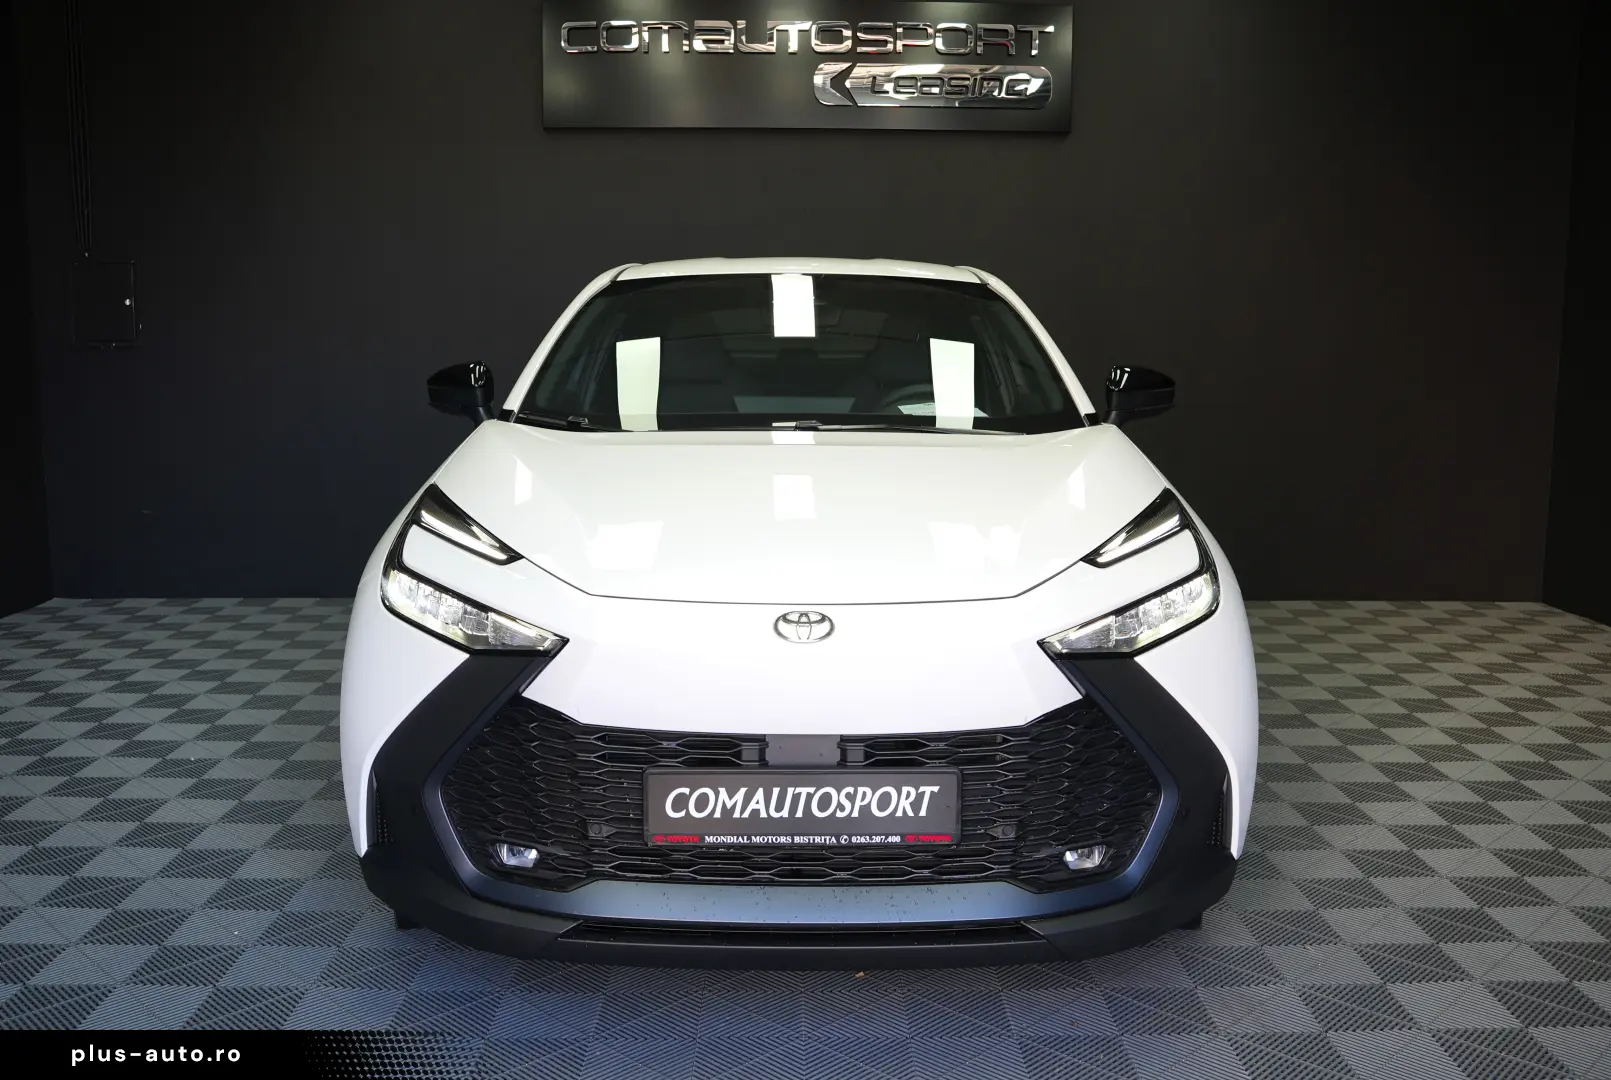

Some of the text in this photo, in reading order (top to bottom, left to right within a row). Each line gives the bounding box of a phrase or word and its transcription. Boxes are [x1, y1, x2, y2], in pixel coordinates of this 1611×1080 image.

[665, 786, 940, 818] COMAUTOSPORT
[704, 835, 750, 844] MONDIAL
[751, 835, 792, 844] MOTORS
[851, 835, 901, 843] 0263.207.400
